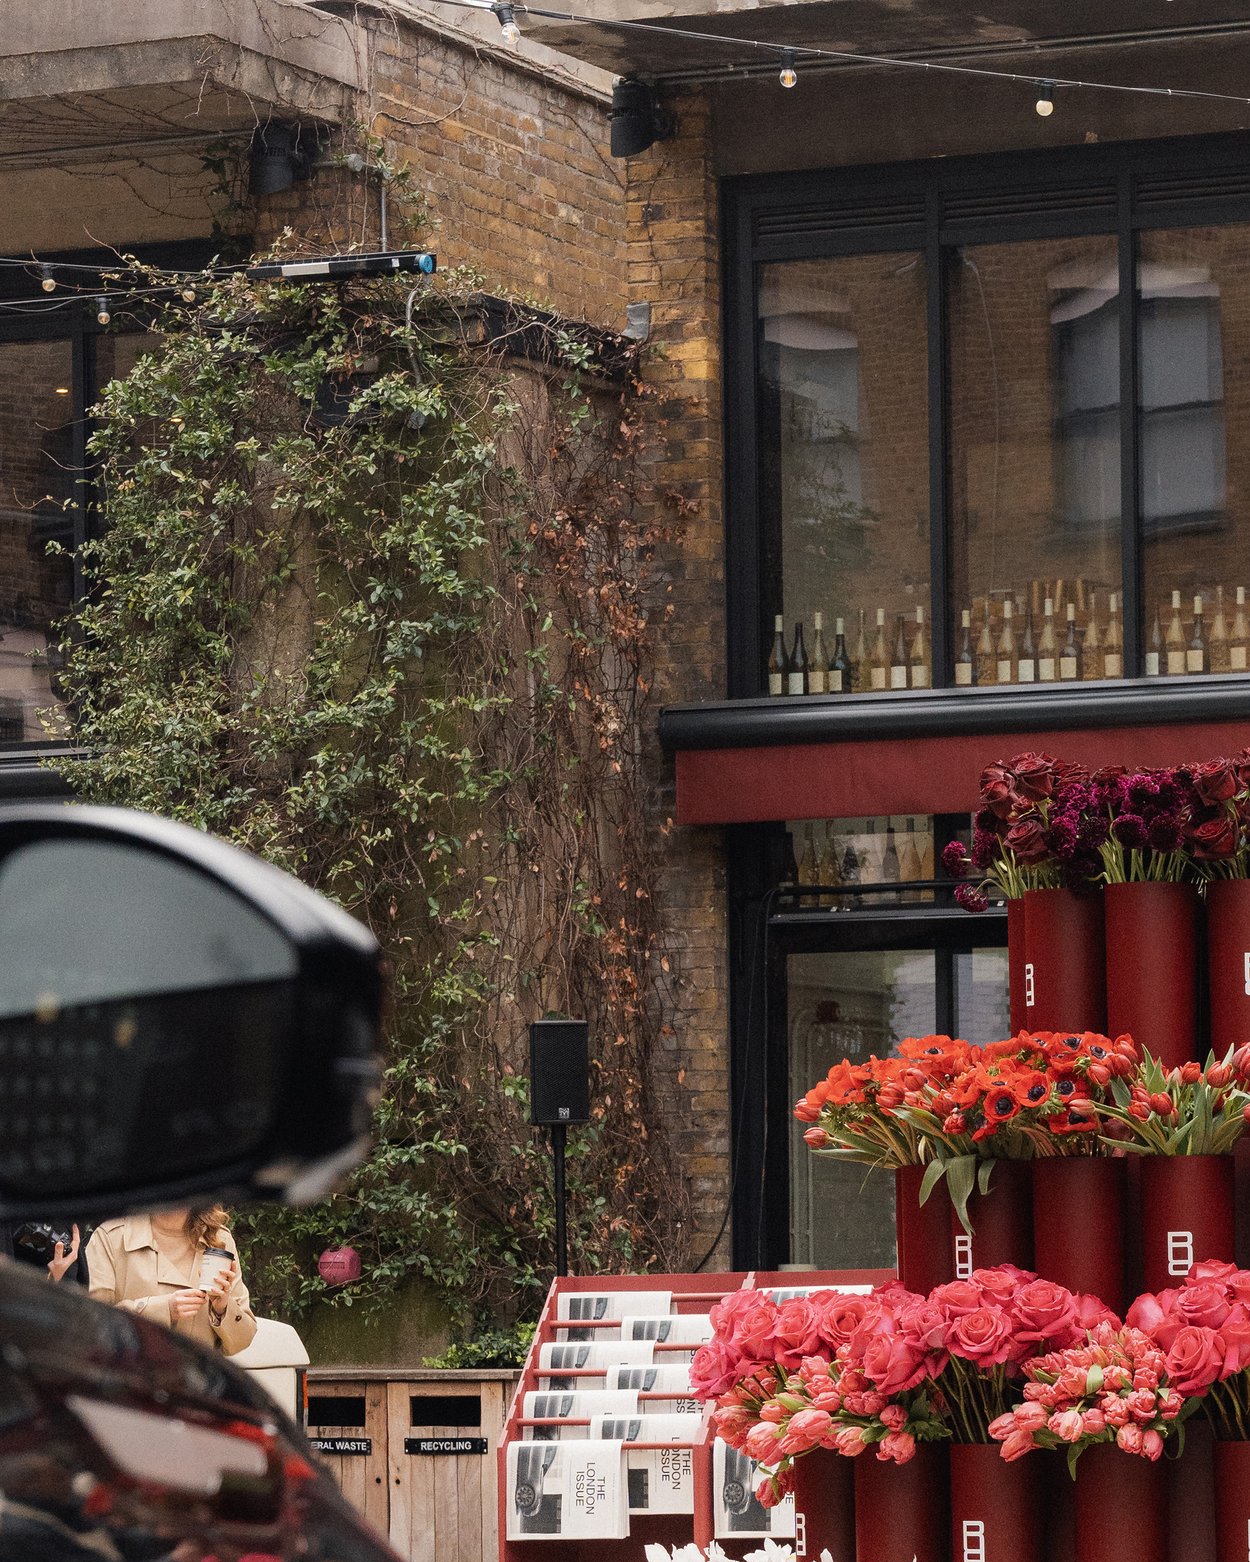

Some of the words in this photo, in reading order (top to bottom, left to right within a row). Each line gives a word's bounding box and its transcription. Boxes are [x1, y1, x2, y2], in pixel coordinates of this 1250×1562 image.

[311, 1441, 334, 1450] ERAL
[335, 1441, 367, 1451] WASTE
[420, 1441, 472, 1451] RECYCLING
[660, 1448, 670, 1481] SSUE
[682, 1451, 691, 1475] THE
[575, 1471, 585, 1506] ISSUE
[586, 1462, 595, 1515] LONDON
[597, 1476, 606, 1500] THE
